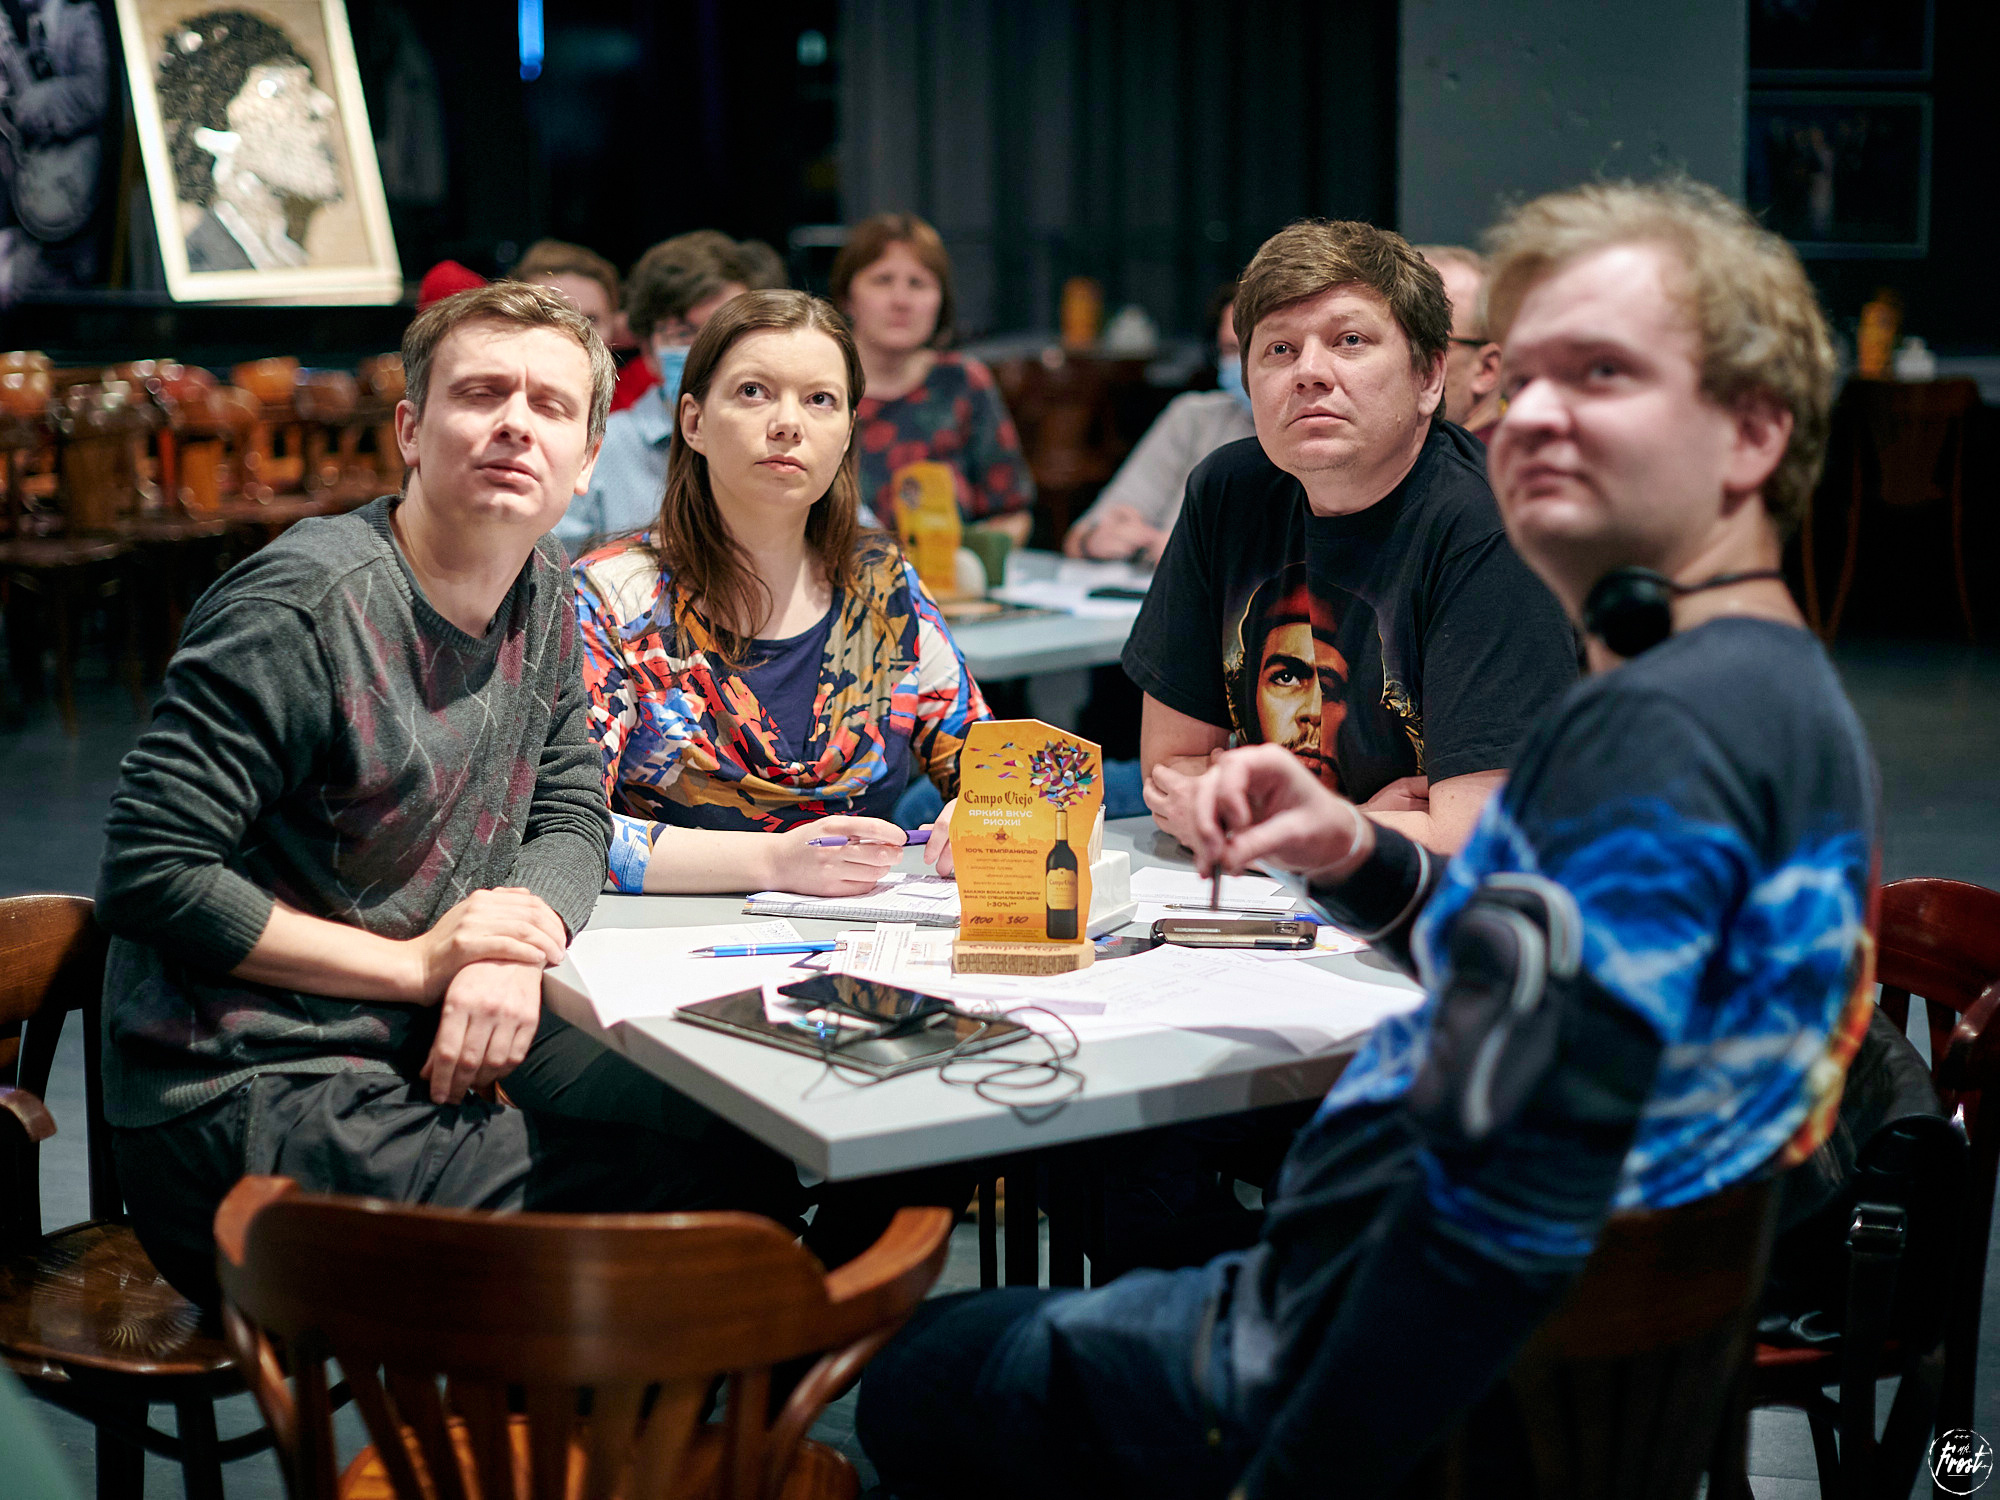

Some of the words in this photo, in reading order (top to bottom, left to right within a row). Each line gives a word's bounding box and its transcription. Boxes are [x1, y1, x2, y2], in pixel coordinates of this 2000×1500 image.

[964, 790, 1002, 808] Campo
[1004, 790, 1033, 808] Viejo
[968, 808, 1003, 817] ЯРКИЙ
[1006, 916, 1029, 924] 360
